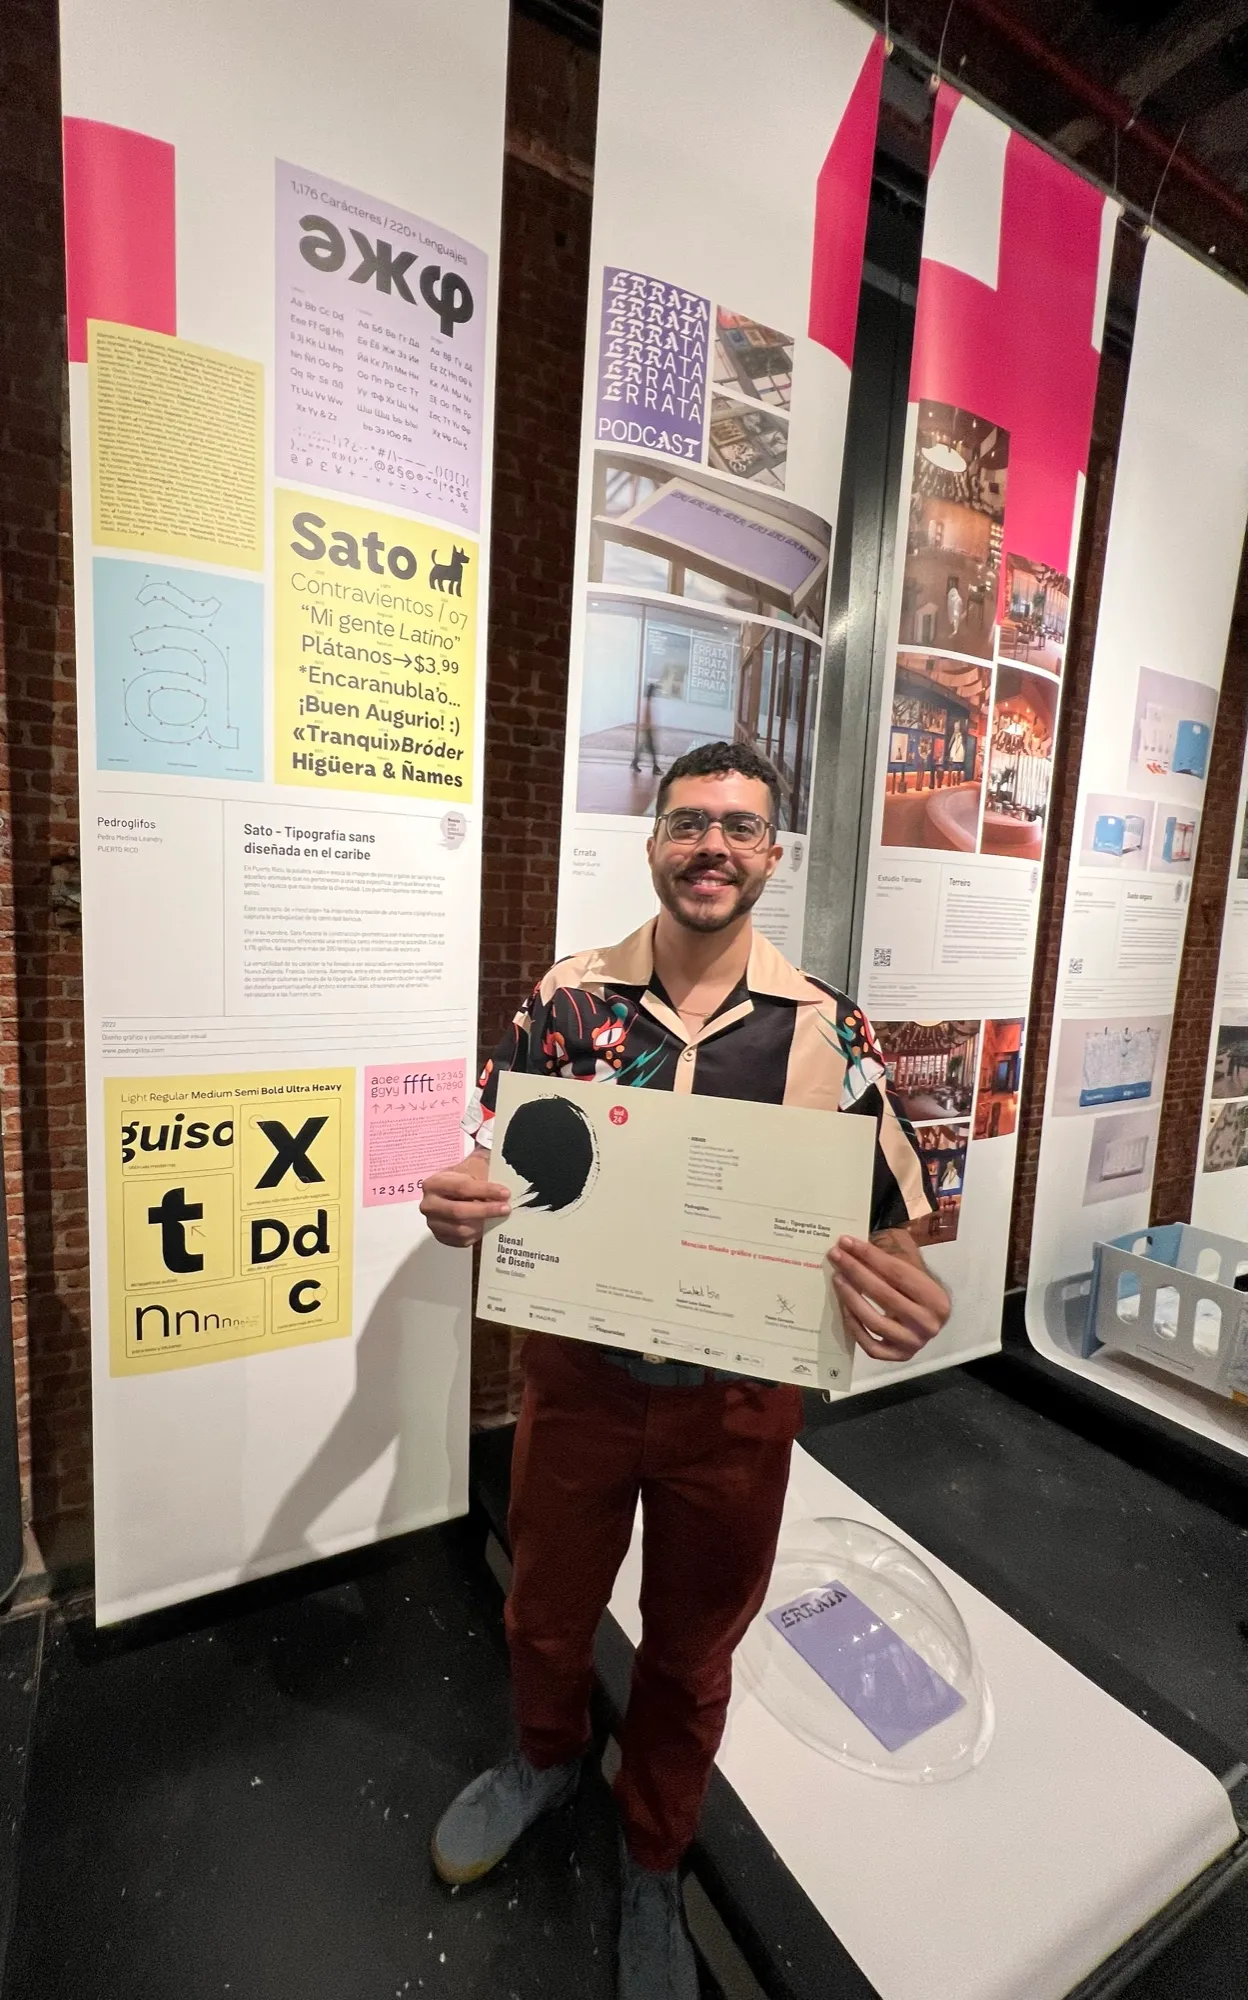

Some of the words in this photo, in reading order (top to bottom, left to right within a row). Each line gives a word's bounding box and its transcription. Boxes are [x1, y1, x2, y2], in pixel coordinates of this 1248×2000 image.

[291, 180, 318, 200] 1,176
[320, 191, 382, 225] Carácteres
[390, 219, 416, 238] 220+
[418, 232, 468, 266] Lenguajes
[608, 272, 708, 322] ERRATA
[606, 294, 704, 342] ERRATA
[605, 316, 704, 363] ERRATA
[604, 338, 703, 384] ERRATA
[603, 360, 702, 404] ERRATA
[602, 381, 701, 425] ERRATA
[599, 417, 701, 458] PODCAST
[290, 512, 417, 580] Sato
[291, 572, 434, 618] Contravientos
[449, 611, 468, 630] 07
[301, 605, 333, 627] “Mi
[339, 614, 395, 637] gente
[400, 623, 461, 650] Latino”
[299, 695, 360, 718] ¡Buen
[366, 704, 445, 731] Augurio!
[292, 752, 376, 777] Higüera
[383, 762, 395, 779] &
[402, 760, 463, 788] Ñames
[97, 817, 156, 830] Pedroglifos
[244, 823, 273, 837] Sato
[349, 832, 376, 843] sans
[244, 843, 301, 857] diseñada
[304, 849, 318, 858] en
[321, 848, 332, 858] el
[334, 848, 371, 860] caribe
[573, 849, 597, 857] Errata
[122, 1093, 148, 1104] Light
[149, 1092, 188, 1103] Regular
[191, 1090, 232, 1099] Medium
[235, 1088, 259, 1096] Semi
[262, 1086, 284, 1095] Bold
[286, 1085, 310, 1093] Ultra
[436, 1071, 463, 1081] 12345
[436, 1081, 463, 1092] 67890
[148, 1187, 203, 1273] t
[251, 1209, 330, 1264] Dd
[499, 1234, 523, 1246] Bienal
[681, 1239, 707, 1250] Mención
[730, 1247, 752, 1258] gráfico
[496, 1255, 506, 1264] de
[508, 1256, 535, 1269] Diseño
[498, 1244, 560, 1263] Iberoamericana
[780, 1589, 848, 1628] ERRATA
